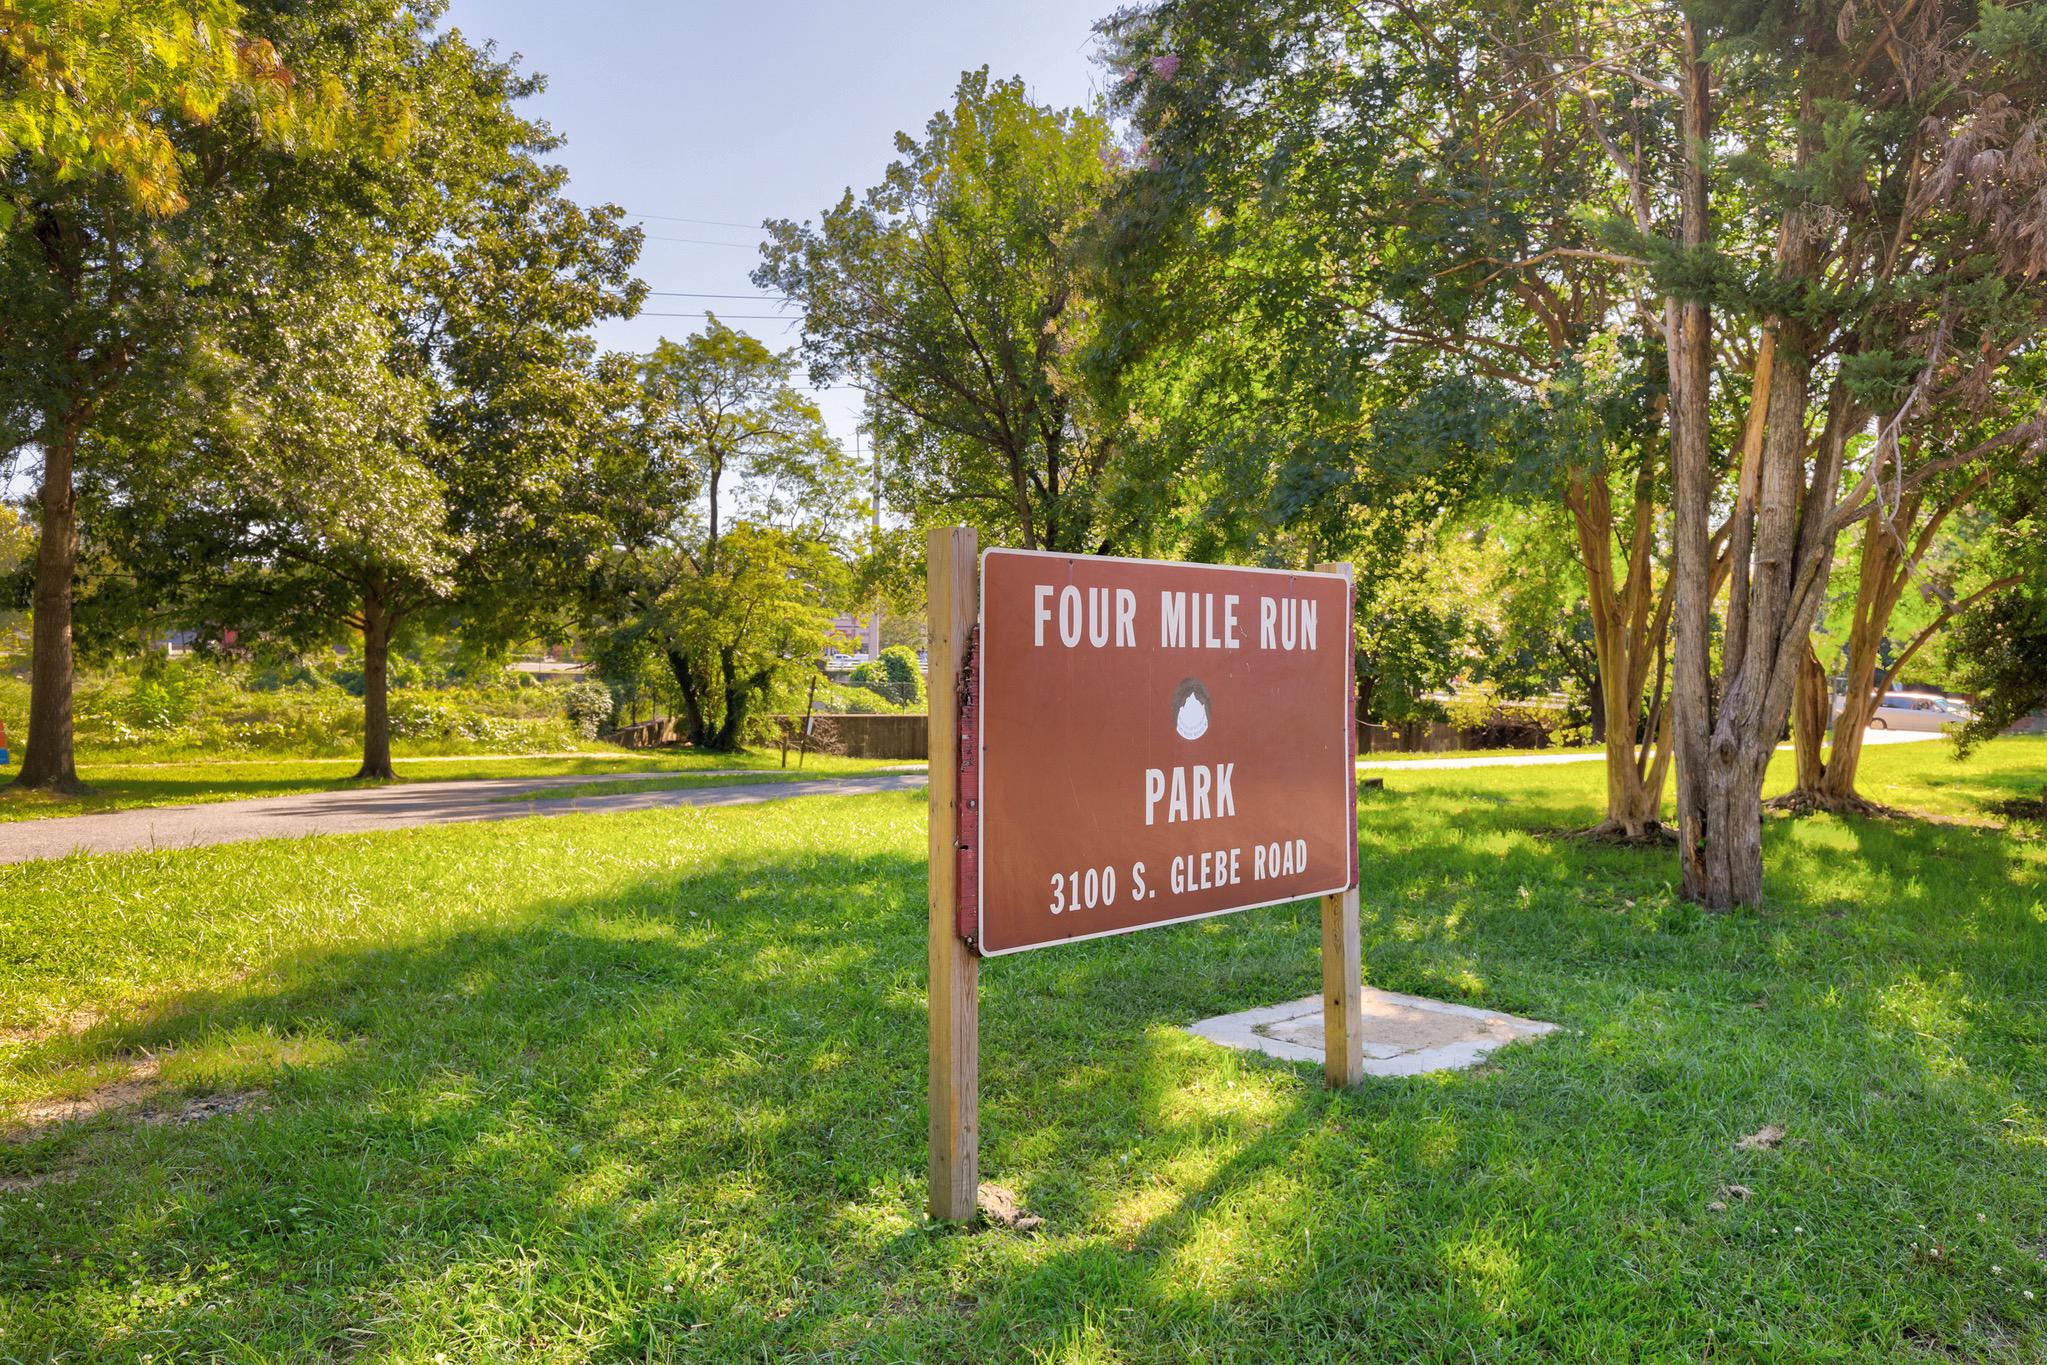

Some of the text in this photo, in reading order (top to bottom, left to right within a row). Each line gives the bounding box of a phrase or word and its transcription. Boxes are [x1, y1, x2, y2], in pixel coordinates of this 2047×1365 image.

[1034, 584, 1318, 651] FOUR MILE RUN
[1145, 763, 1236, 826] PARK
[1049, 839, 1308, 915] 3100 S. GLEBE ROAD
